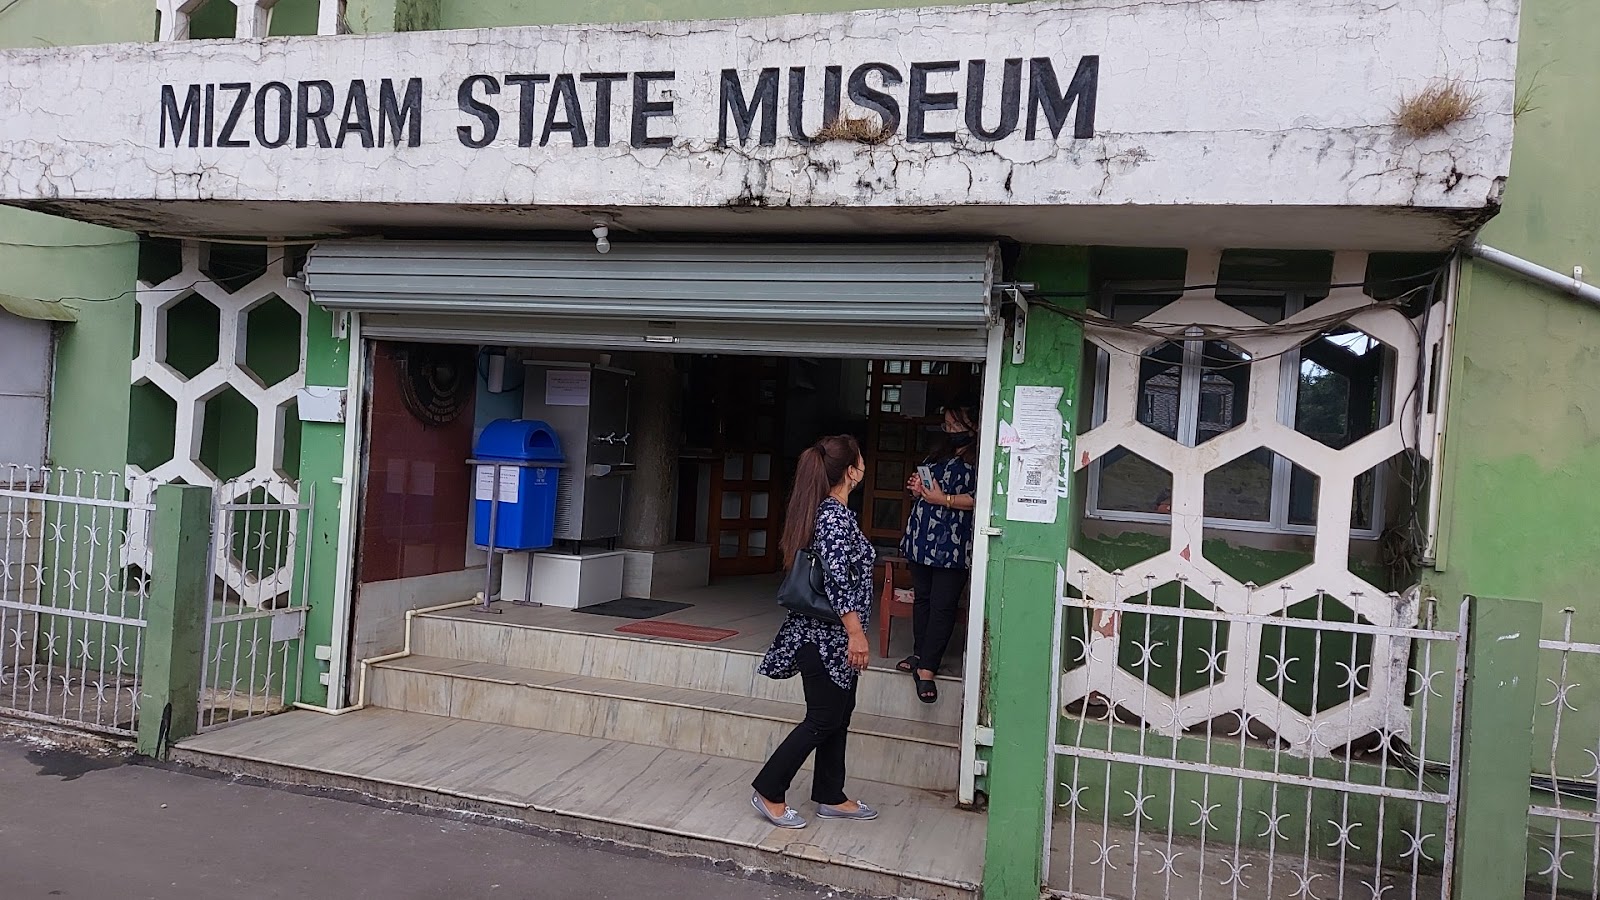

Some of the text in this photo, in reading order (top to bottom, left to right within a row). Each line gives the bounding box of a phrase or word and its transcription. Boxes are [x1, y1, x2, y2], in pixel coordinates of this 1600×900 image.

[159, 54, 1100, 150] MIZORAM STATE MUSEUM
